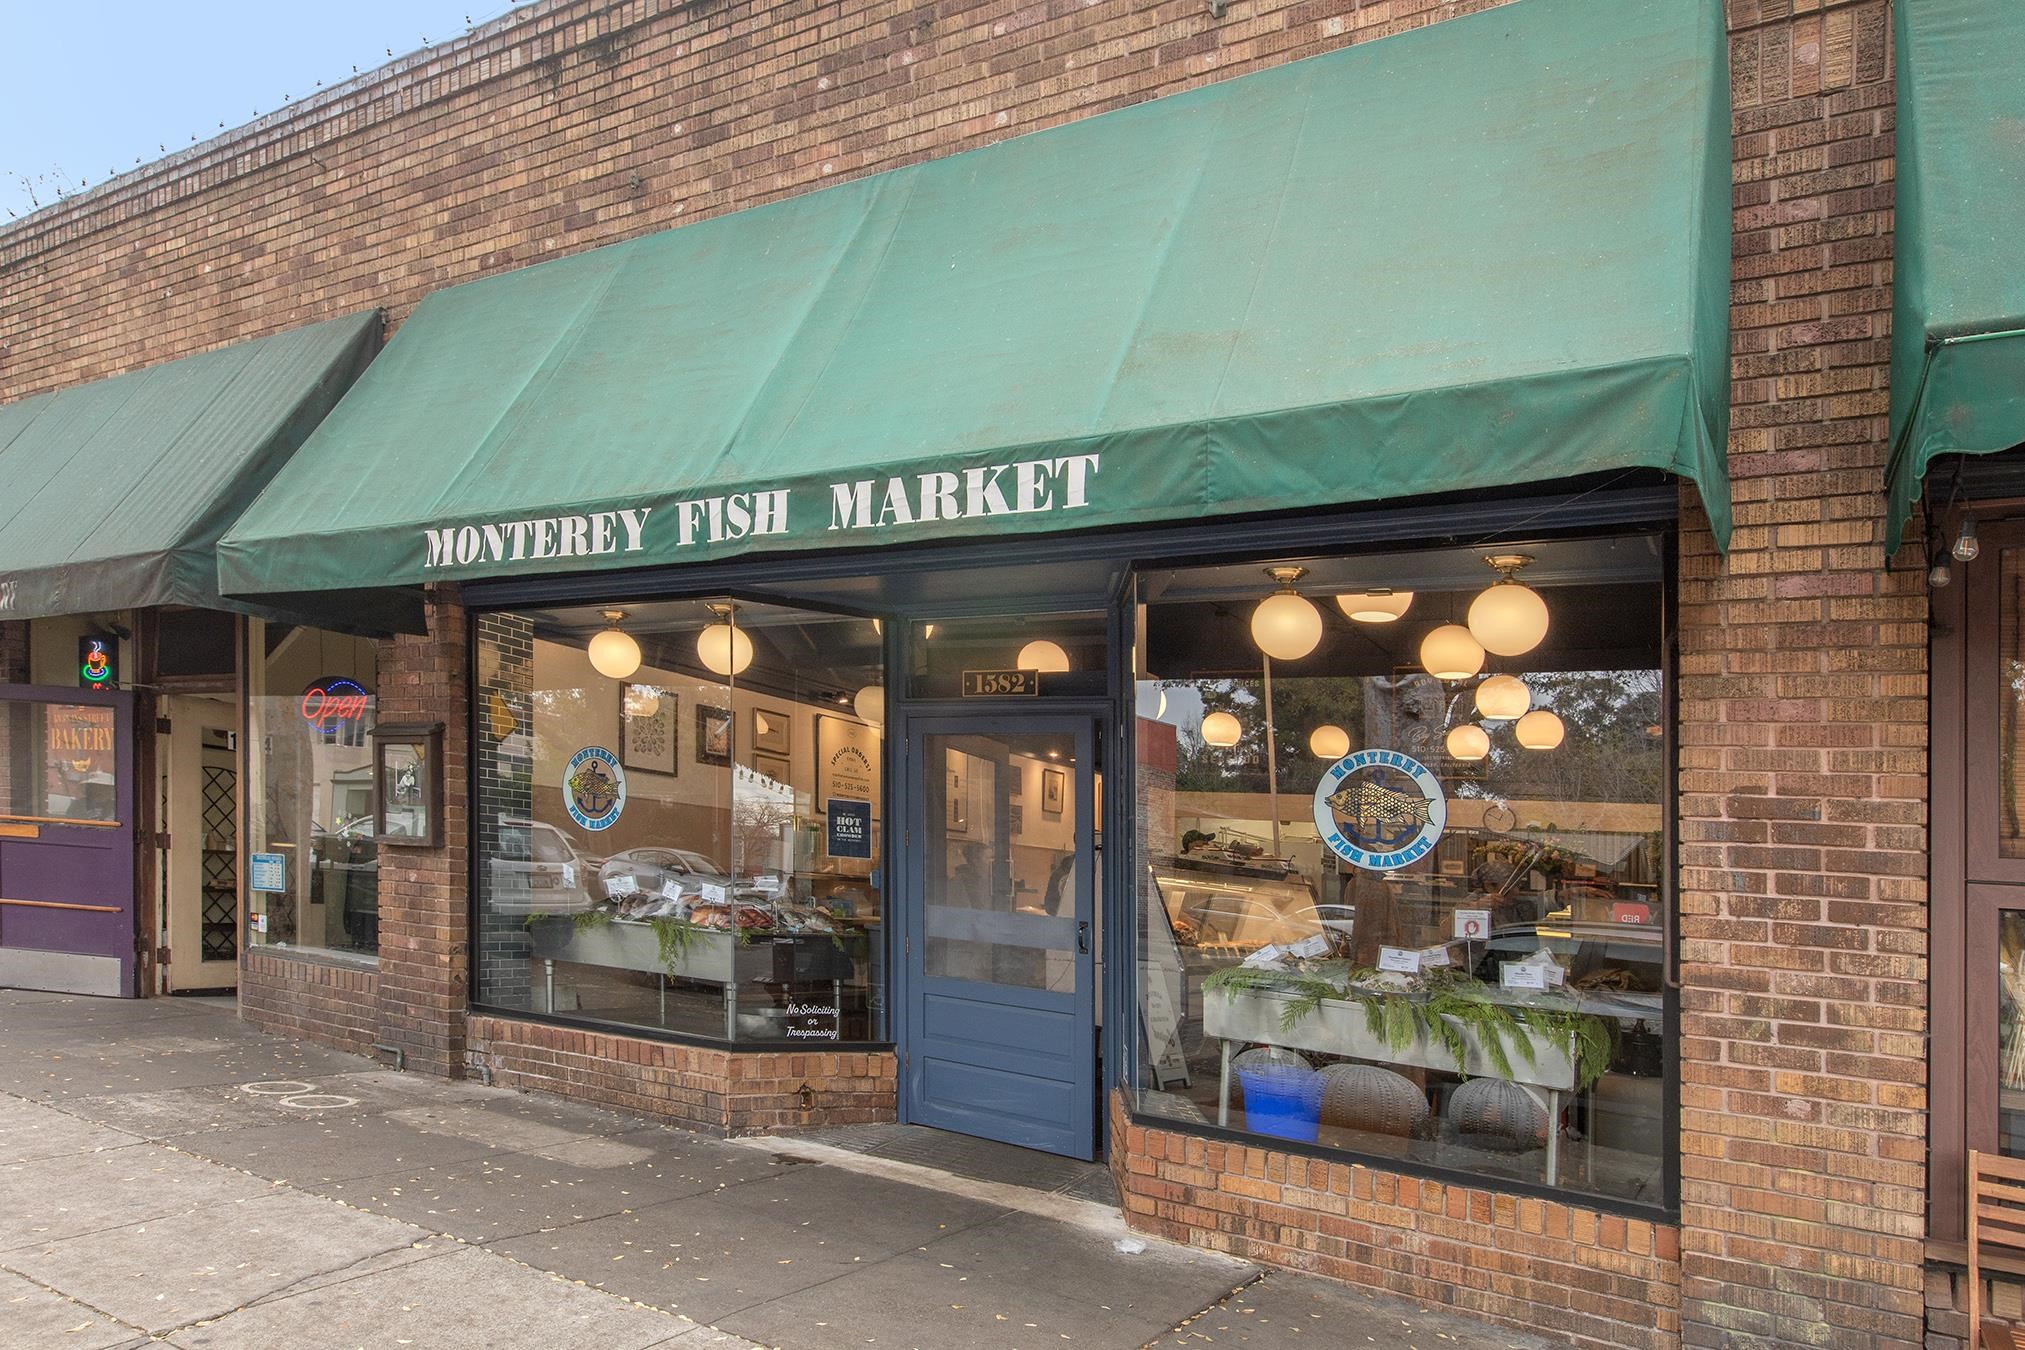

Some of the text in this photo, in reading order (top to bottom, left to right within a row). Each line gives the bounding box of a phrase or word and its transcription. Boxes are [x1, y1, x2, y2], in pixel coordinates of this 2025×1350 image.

[424, 453, 1101, 568] MONTEREY FISH MARKET
[974, 672, 1026, 694] 1582
[301, 687, 366, 728] Open
[51, 727, 113, 751] BAKERY
[571, 748, 618, 769] MONTEREY
[831, 747, 850, 766] SPECIAL
[1330, 751, 1427, 781] MONTEREY
[836, 816, 862, 826] HOT
[836, 825, 862, 834] CLAM
[1328, 832, 1433, 867] FISH MARKET
[786, 1003, 840, 1018] No Soliciting
[807, 1018, 819, 1026] or
[786, 1026, 838, 1041] Trespassing
